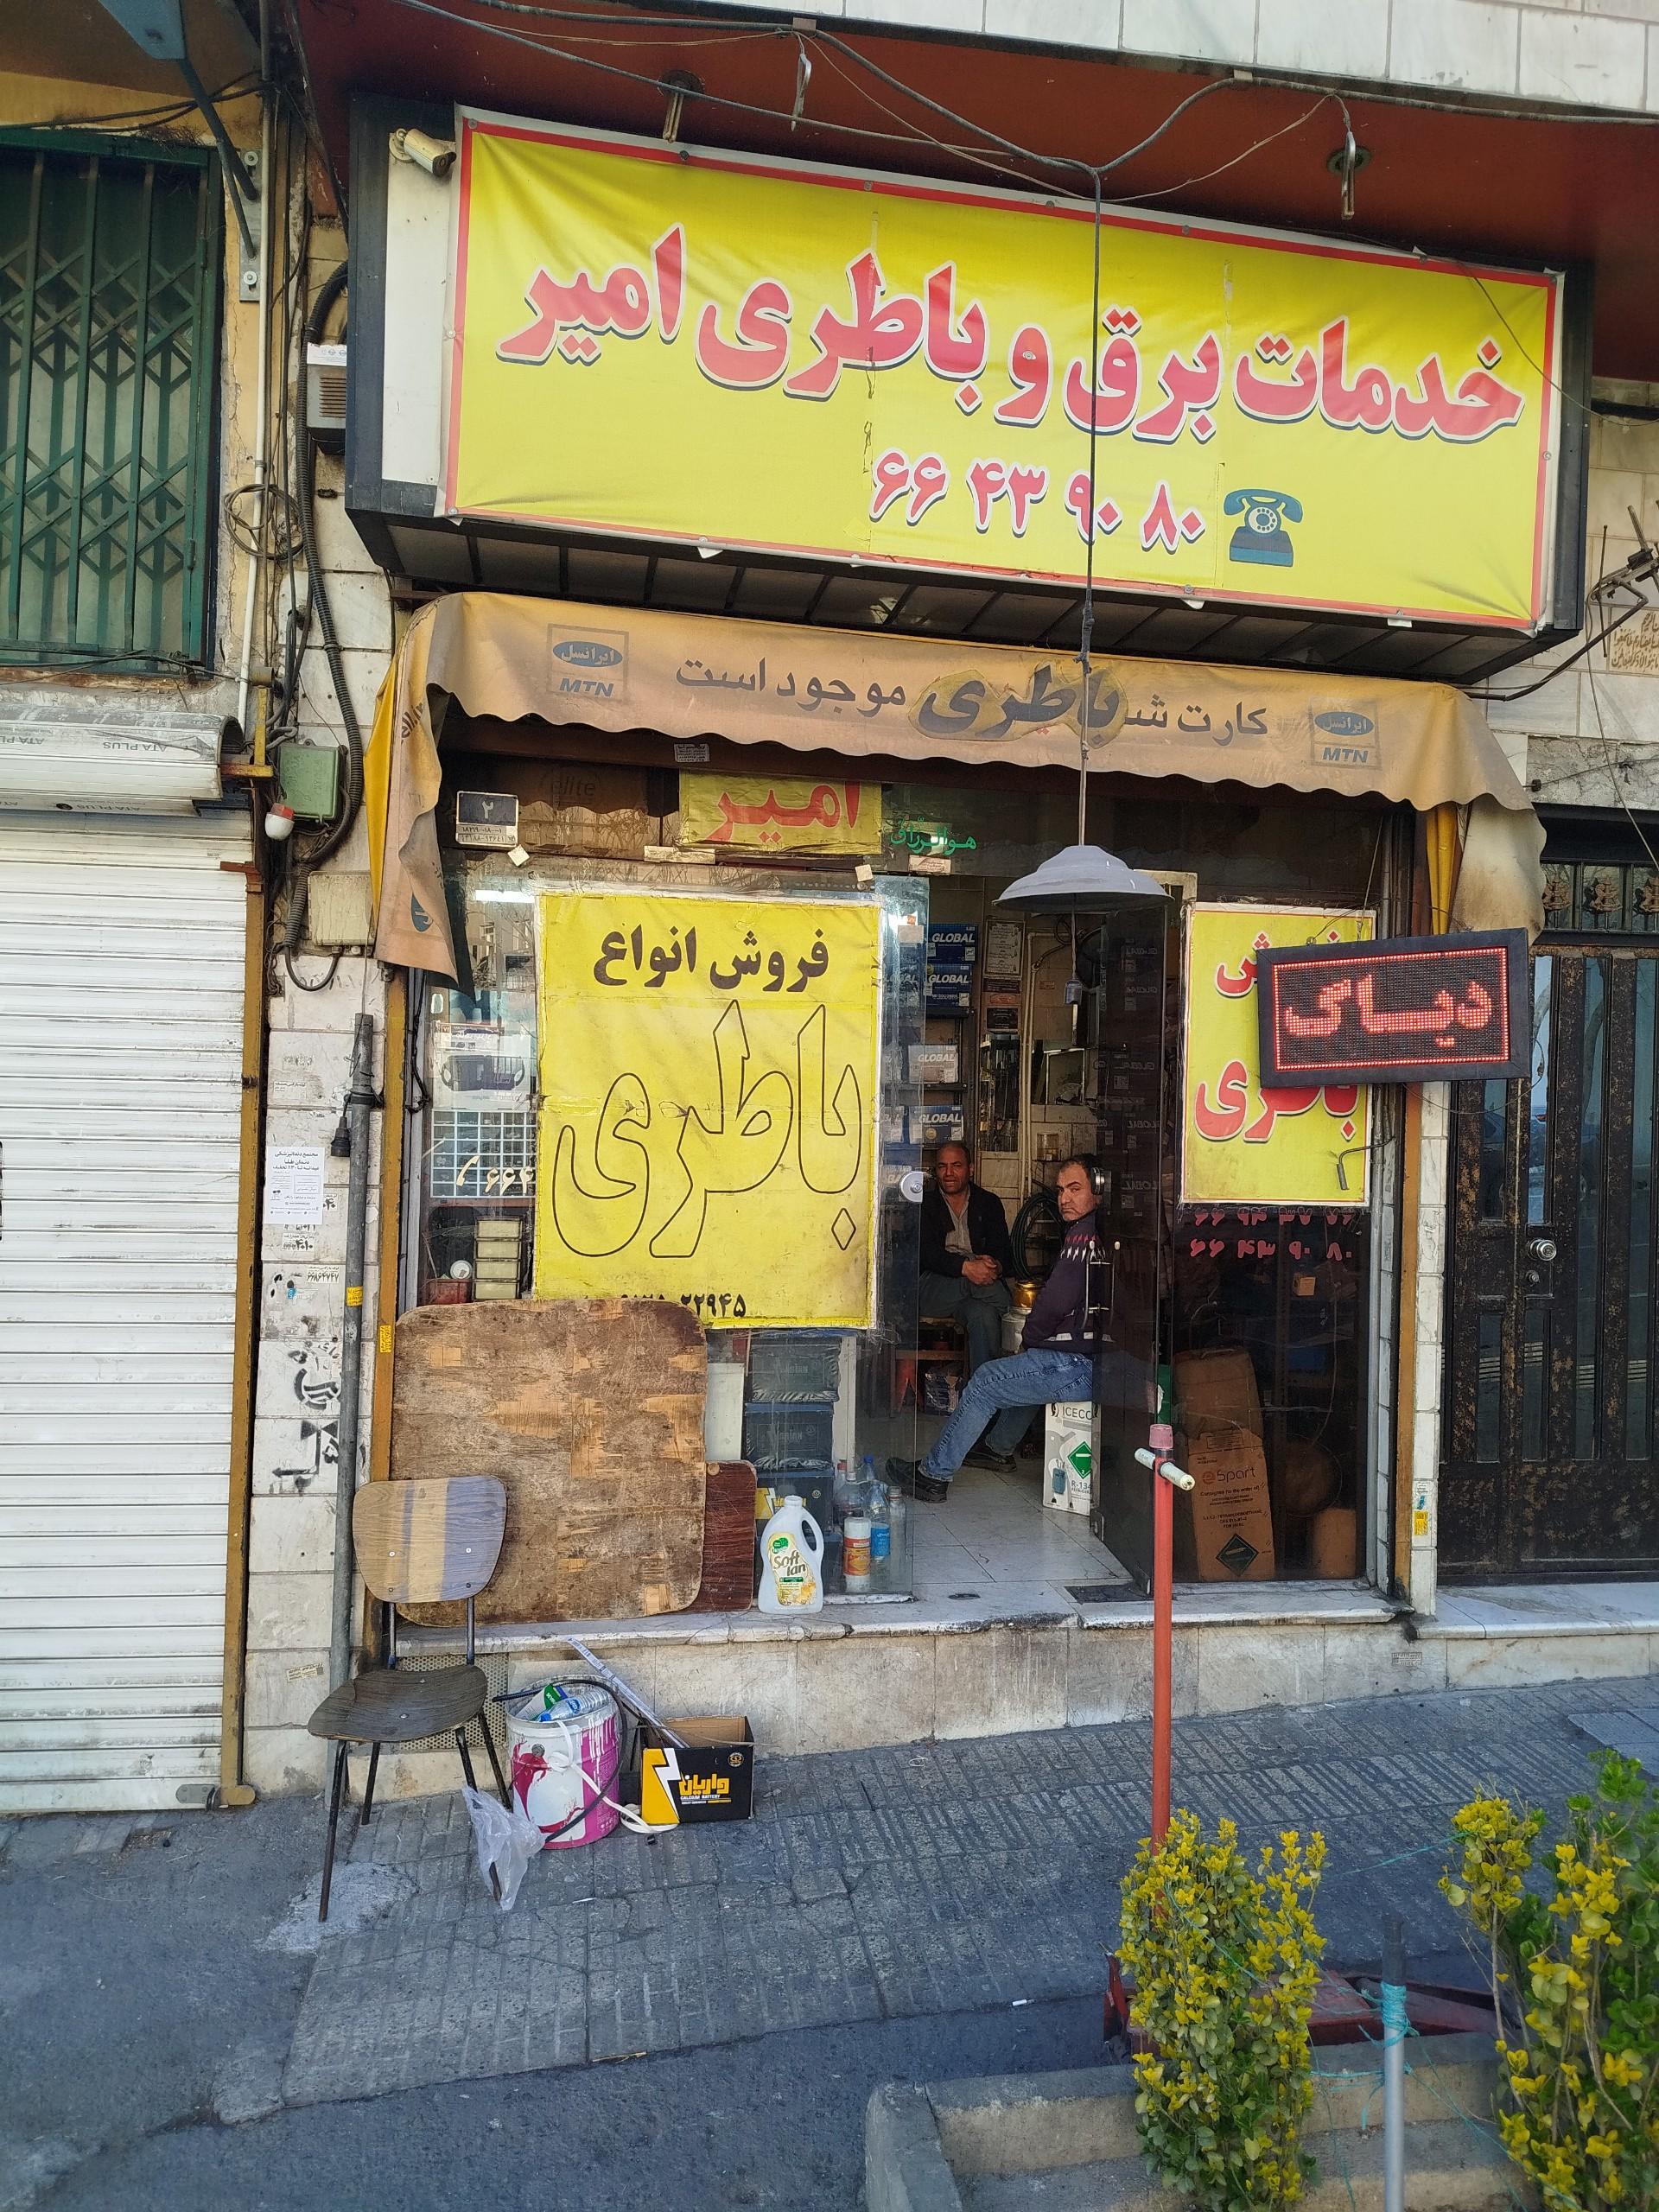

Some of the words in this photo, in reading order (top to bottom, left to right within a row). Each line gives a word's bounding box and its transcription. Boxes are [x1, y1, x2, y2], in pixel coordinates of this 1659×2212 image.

[498, 224, 686, 365] امیر
[695, 247, 988, 416] باطری
[996, 325, 1052, 427] و
[1064, 306, 1223, 444] برق
[1234, 316, 1525, 442] خدمات
[560, 678, 613, 697] MTN
[676, 657, 766, 692] است
[776, 671, 906, 718] موجود
[918, 664, 1121, 746] باطری
[1177, 702, 1268, 747] کارت
[1322, 747, 1369, 763] MTN
[704, 781, 861, 842] امیر
[594, 924, 697, 988] انواع
[710, 928, 830, 993] فروش
[932, 933, 976, 943] GLOBAL
[929, 974, 969, 984] GLOBAL
[918, 1054, 956, 1063] GLOBAL
[552, 999, 862, 1258] باطری
[918, 1114, 962, 1123] GLOBAL
[773, 1550, 800, 1569] Soft
[678, 1771, 730, 1796] واریان
